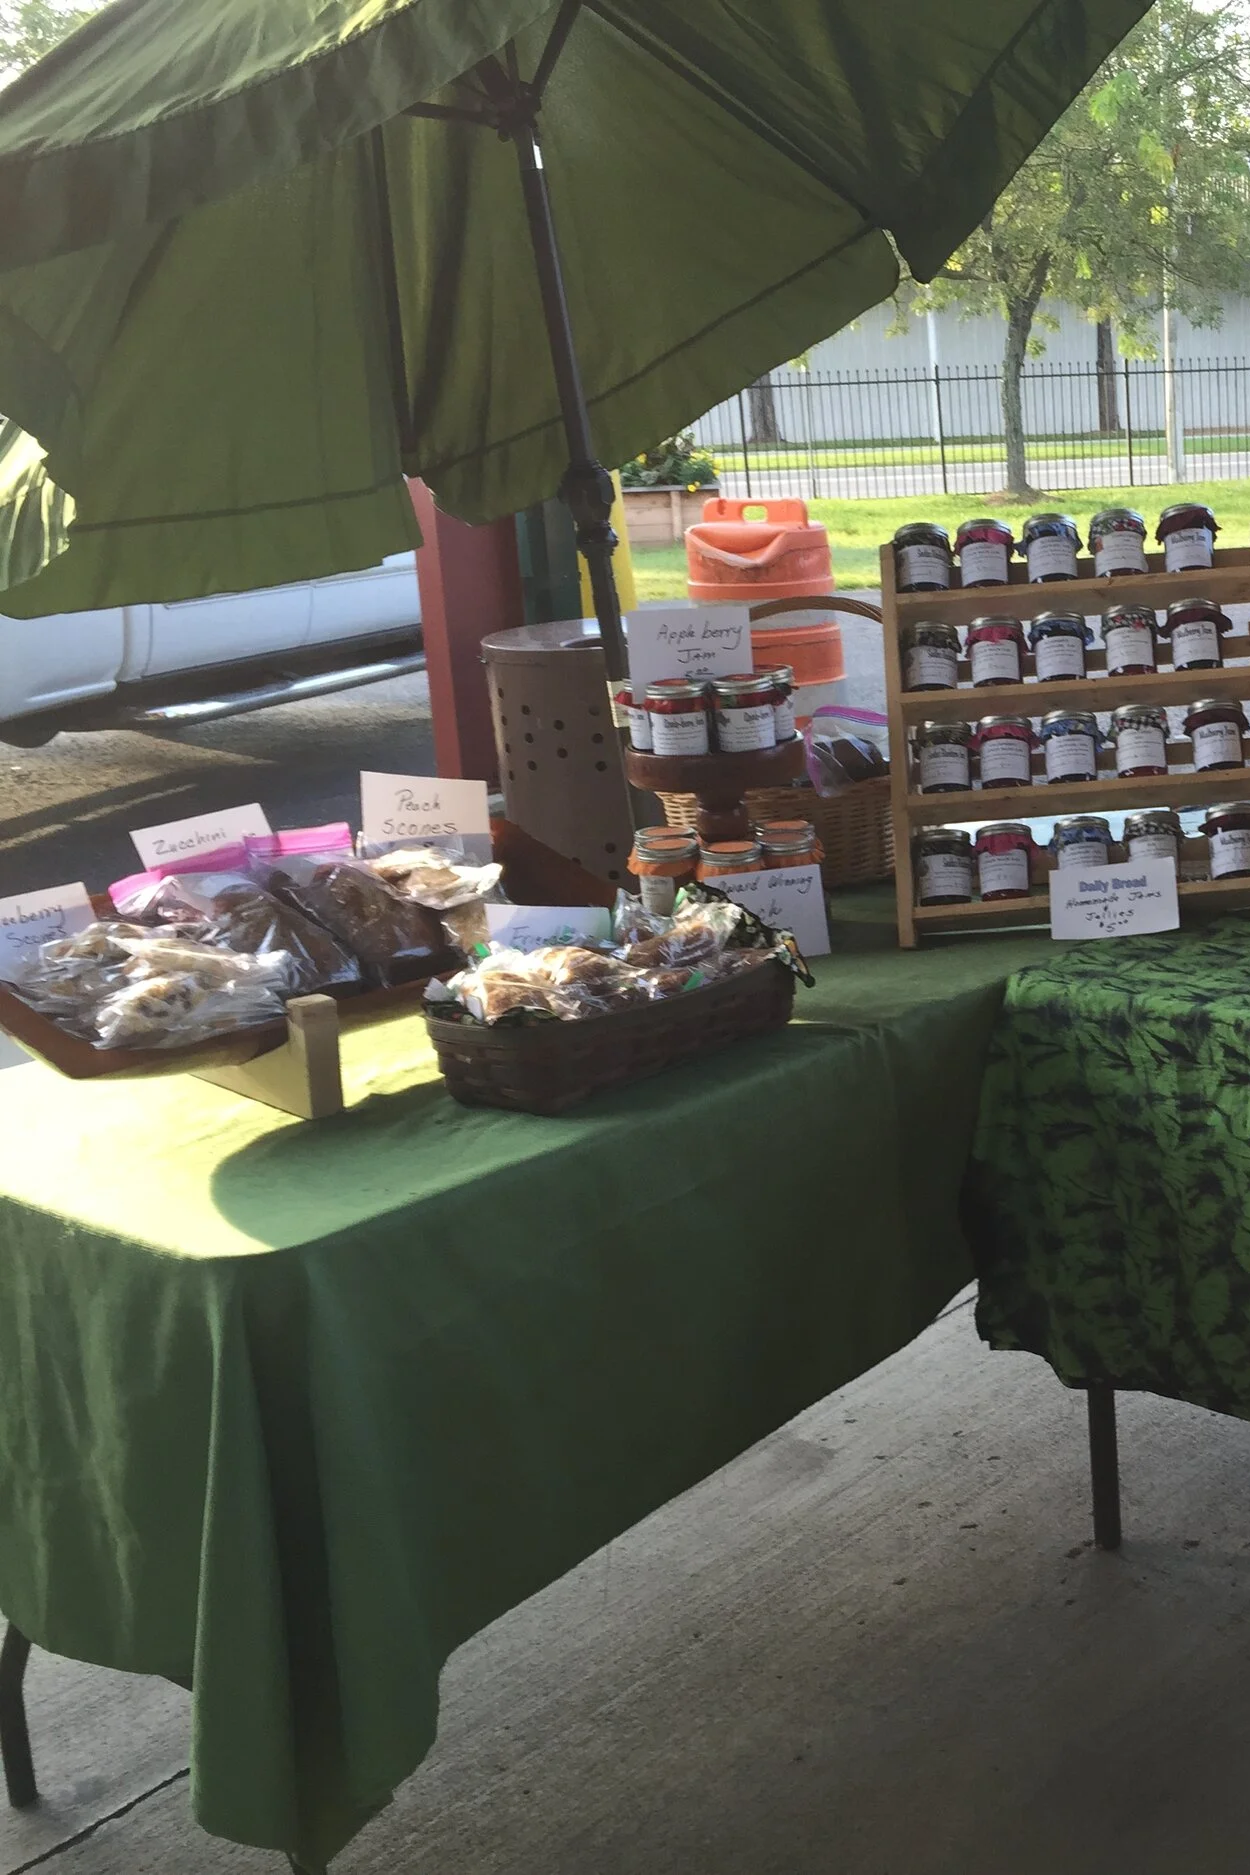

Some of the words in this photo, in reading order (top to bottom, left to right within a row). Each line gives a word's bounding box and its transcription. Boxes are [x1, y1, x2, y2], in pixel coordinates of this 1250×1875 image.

[394, 788, 441, 812] Peach
[152, 827, 227, 856] Zucchini
[1079, 880, 1109, 894] Daily
